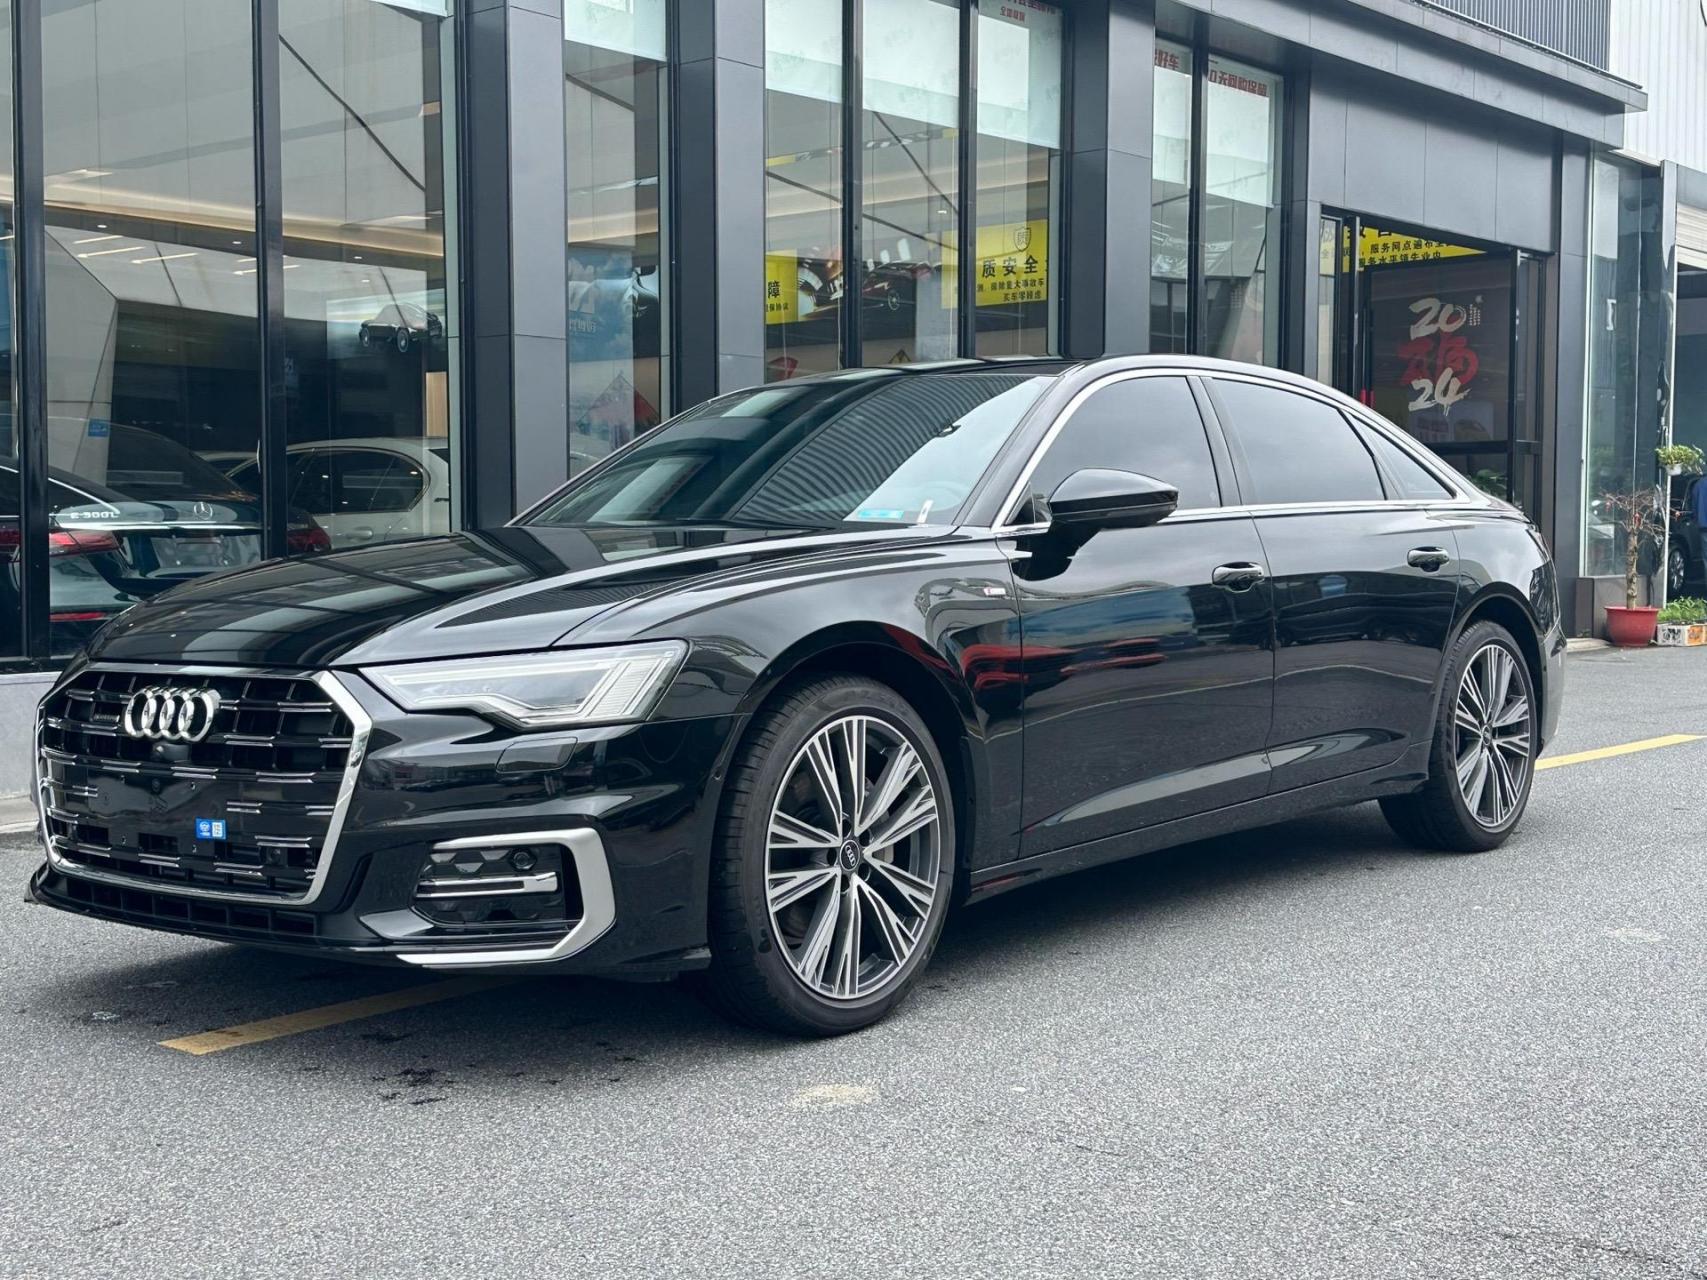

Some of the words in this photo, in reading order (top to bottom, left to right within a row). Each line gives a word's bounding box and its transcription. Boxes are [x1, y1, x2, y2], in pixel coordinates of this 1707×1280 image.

[982, 255, 1047, 279] 质安全
[767, 280, 780, 299] 障
[1409, 297, 1467, 341] 20
[1408, 366, 1472, 417] 24
